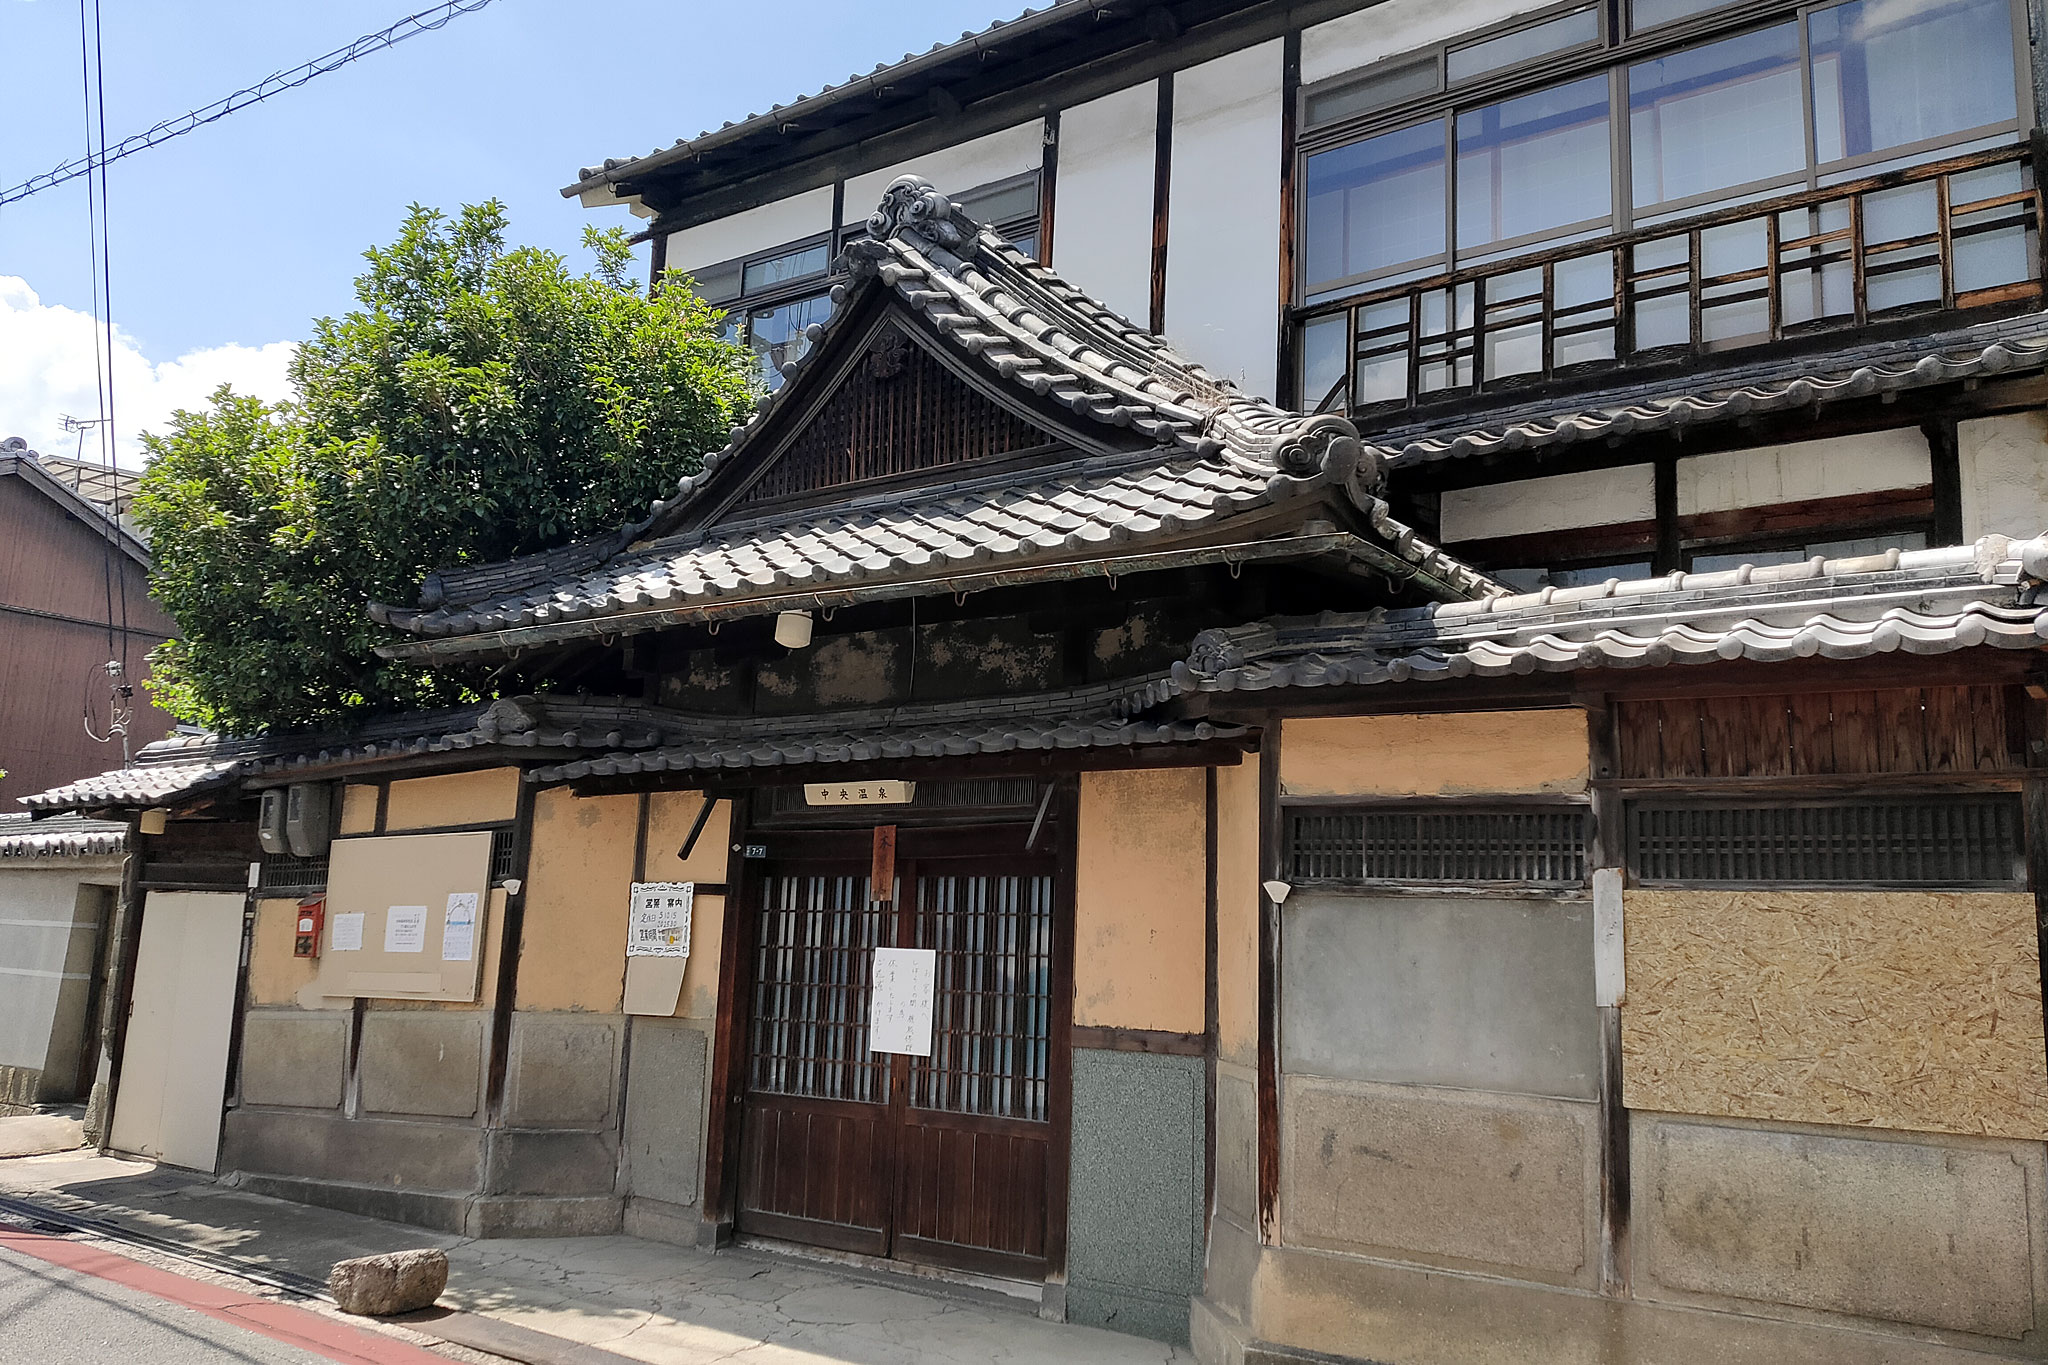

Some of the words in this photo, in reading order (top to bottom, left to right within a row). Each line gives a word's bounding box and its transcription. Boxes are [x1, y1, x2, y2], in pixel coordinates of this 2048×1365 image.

[820, 786, 888, 802] 中央温泉
[645, 898, 660, 908] 営業
[667, 897, 682, 907] 案内
